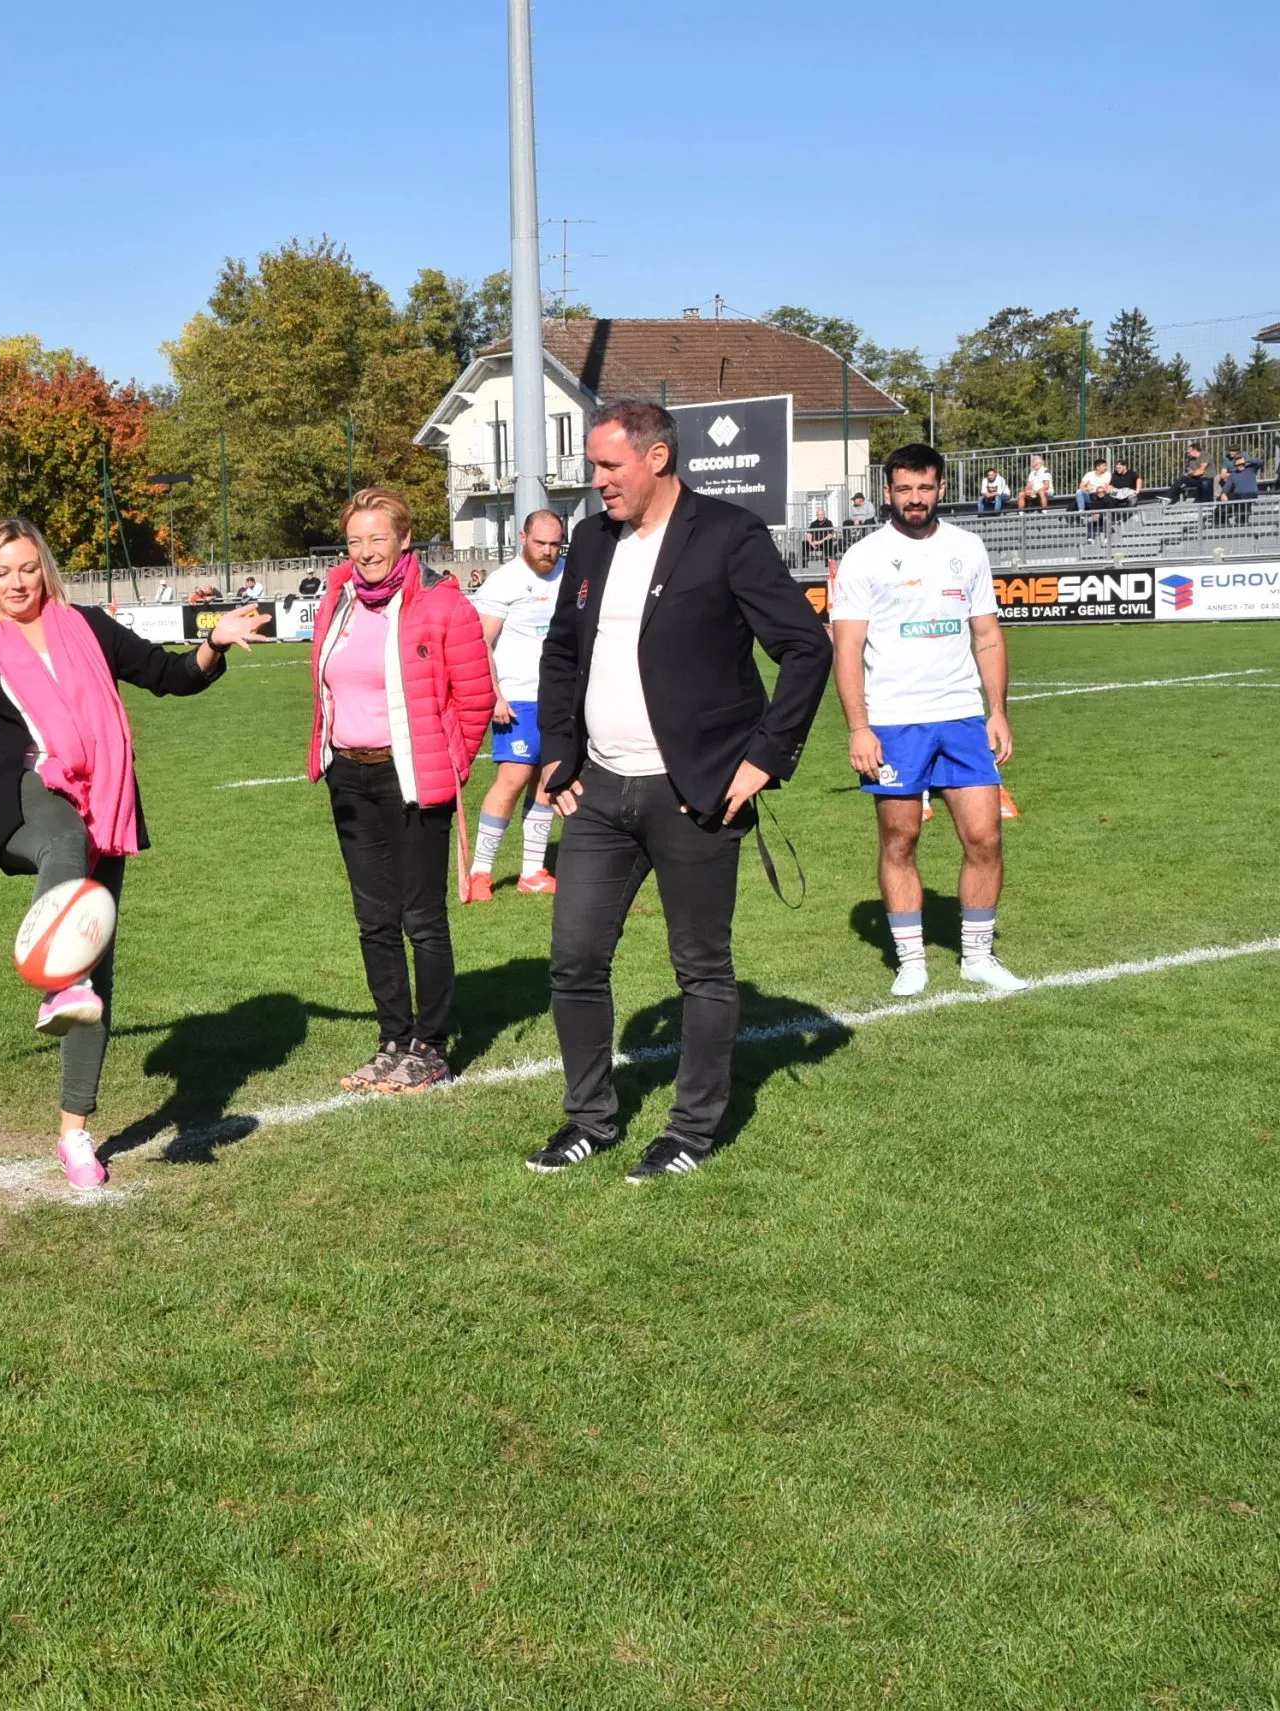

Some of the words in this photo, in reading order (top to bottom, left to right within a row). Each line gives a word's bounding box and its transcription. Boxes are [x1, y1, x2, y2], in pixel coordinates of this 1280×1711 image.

[736, 454, 760, 468] BTP
[725, 484, 736, 494] de
[737, 483, 766, 493] talents
[997, 605, 1029, 618] AGES
[1032, 605, 1068, 617] D'ART
[1077, 604, 1116, 616] GENIE
[1119, 603, 1153, 615] CIVIL
[1207, 603, 1238, 611] ANNECY
[903, 621, 960, 636] SANYTOL
